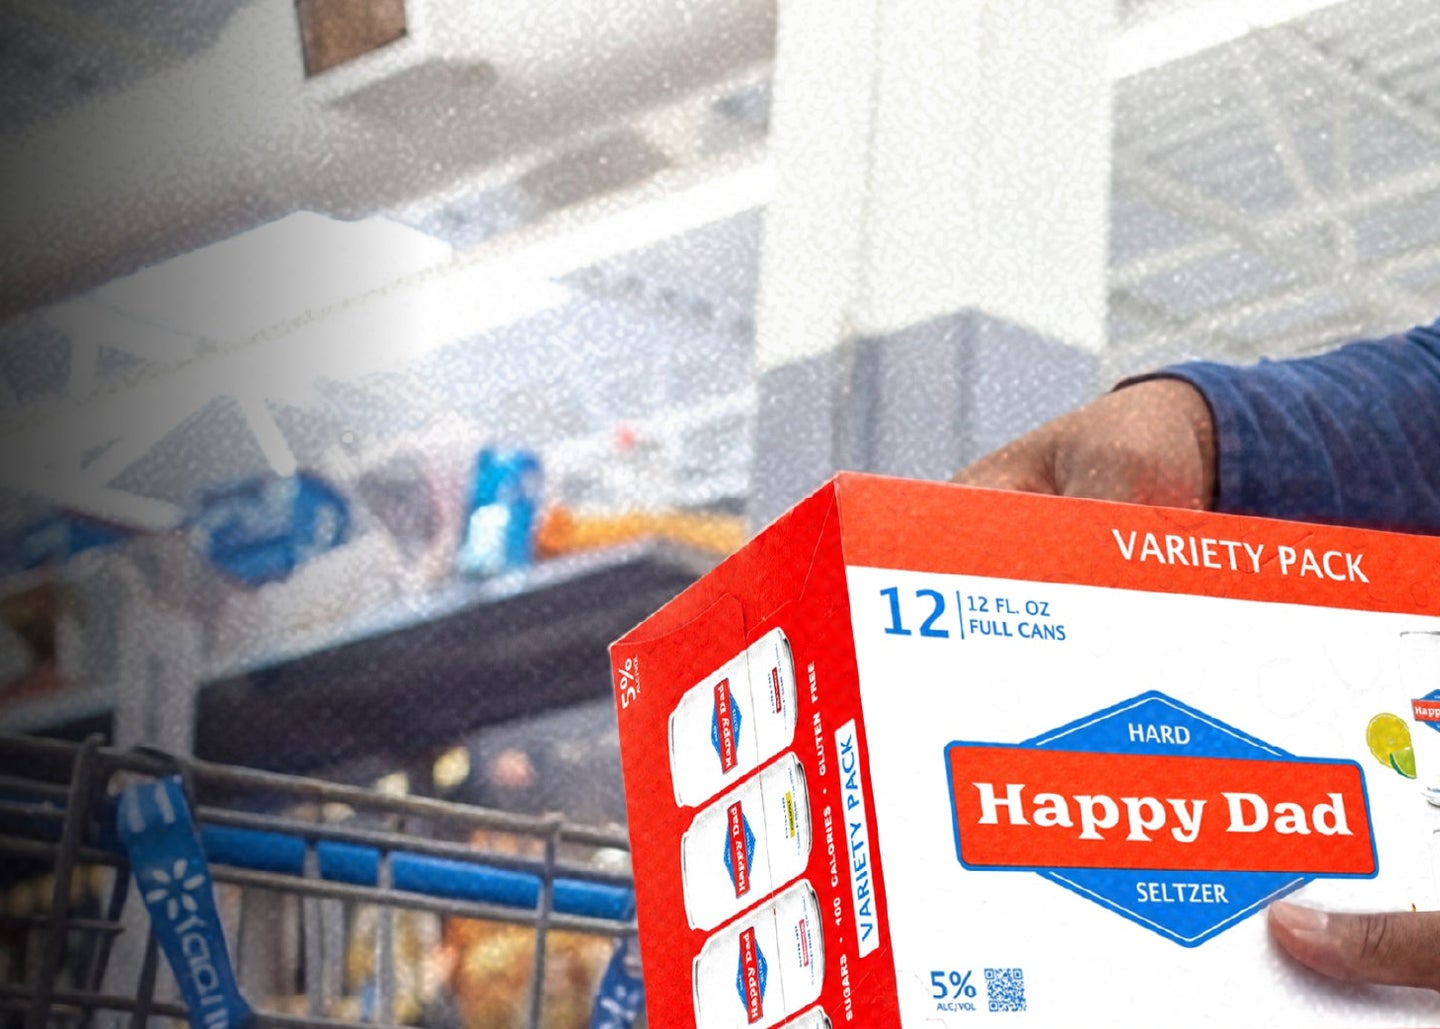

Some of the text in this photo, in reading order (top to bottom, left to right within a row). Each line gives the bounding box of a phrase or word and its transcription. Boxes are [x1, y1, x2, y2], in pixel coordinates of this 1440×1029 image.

[1112, 528, 1370, 583] VARIETY PACK
[880, 586, 949, 638] 12
[967, 596, 1051, 617] 12 FL. OZ
[970, 620, 1066, 641] FULL CANS
[618, 657, 636, 709] 5%
[807, 662, 818, 703] FREE
[717, 683, 732, 768] Happy Dad
[812, 712, 826, 776] GLUTEN
[1128, 723, 1190, 745] HARD
[840, 733, 874, 943] VARIETY PACK
[972, 782, 1354, 843] Happy Dad
[730, 805, 746, 892] Happy Dad
[823, 805, 839, 888] CALORIES
[832, 897, 843, 926] 100
[1137, 881, 1229, 904] SELTZER
[743, 931, 758, 1019] Happy Dad
[839, 953, 854, 1021] SUGARS
[930, 970, 977, 999] 5%
[936, 1002, 977, 1012] ALC/VOL
